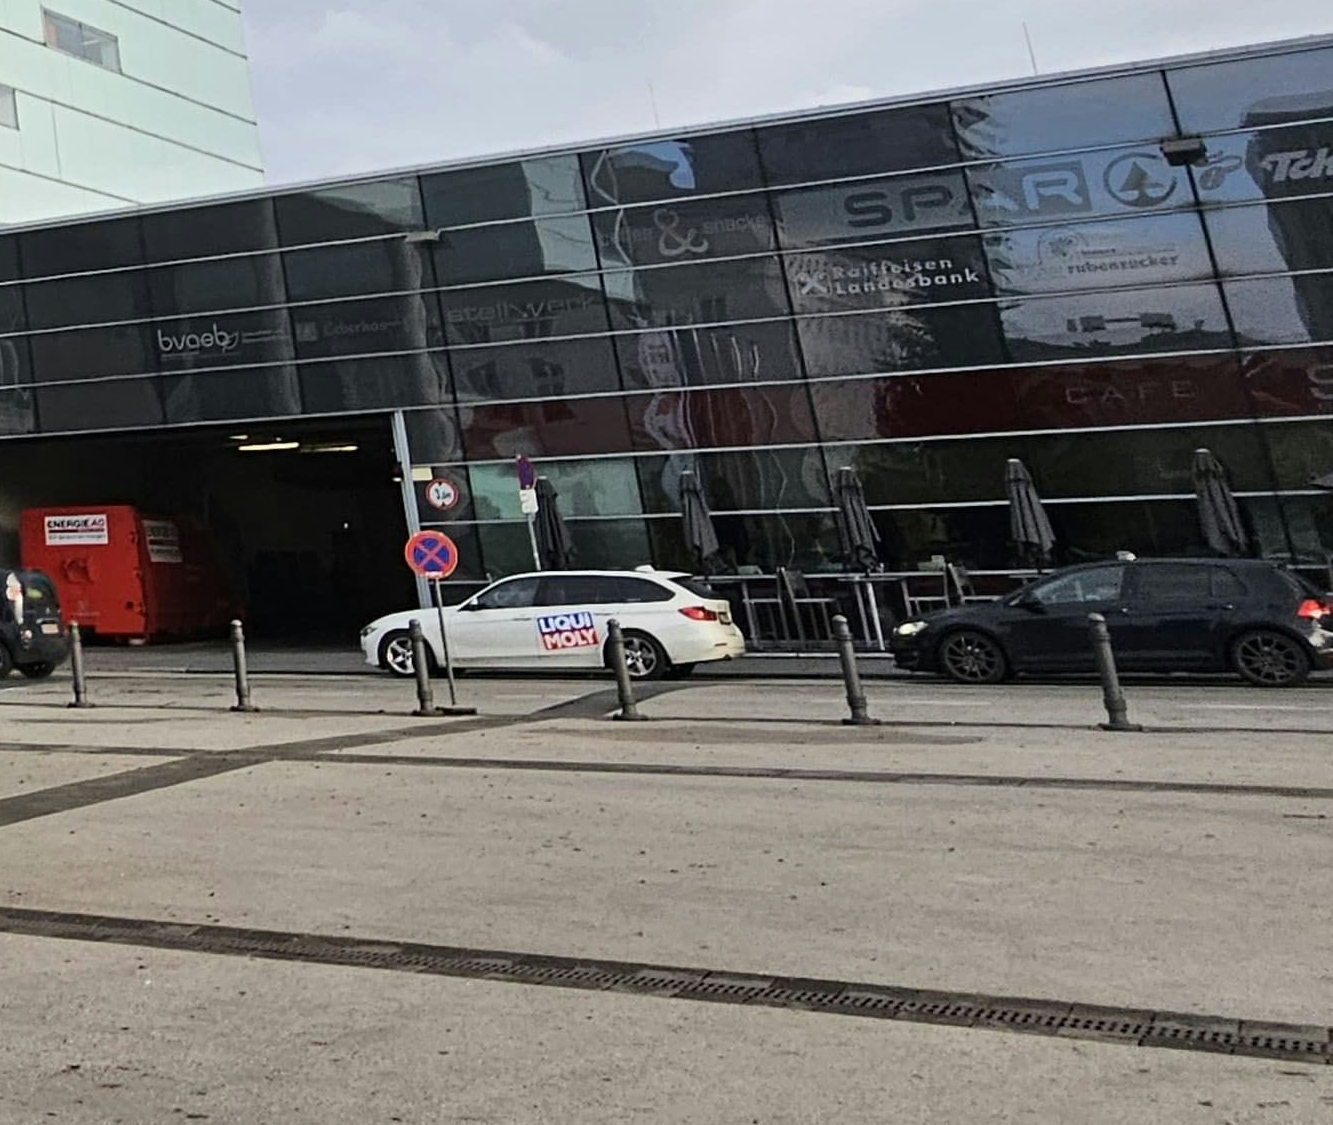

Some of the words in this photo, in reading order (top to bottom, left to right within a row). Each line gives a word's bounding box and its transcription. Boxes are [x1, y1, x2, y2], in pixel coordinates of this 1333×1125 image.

[844, 170, 1084, 229] SPAR
[834, 256, 954, 280] Raiffeisen
[835, 271, 981, 298] Landesbank
[157, 322, 232, 354] bvaeb
[539, 613, 592, 633] LIQUI
[544, 629, 598, 650] MOLY
